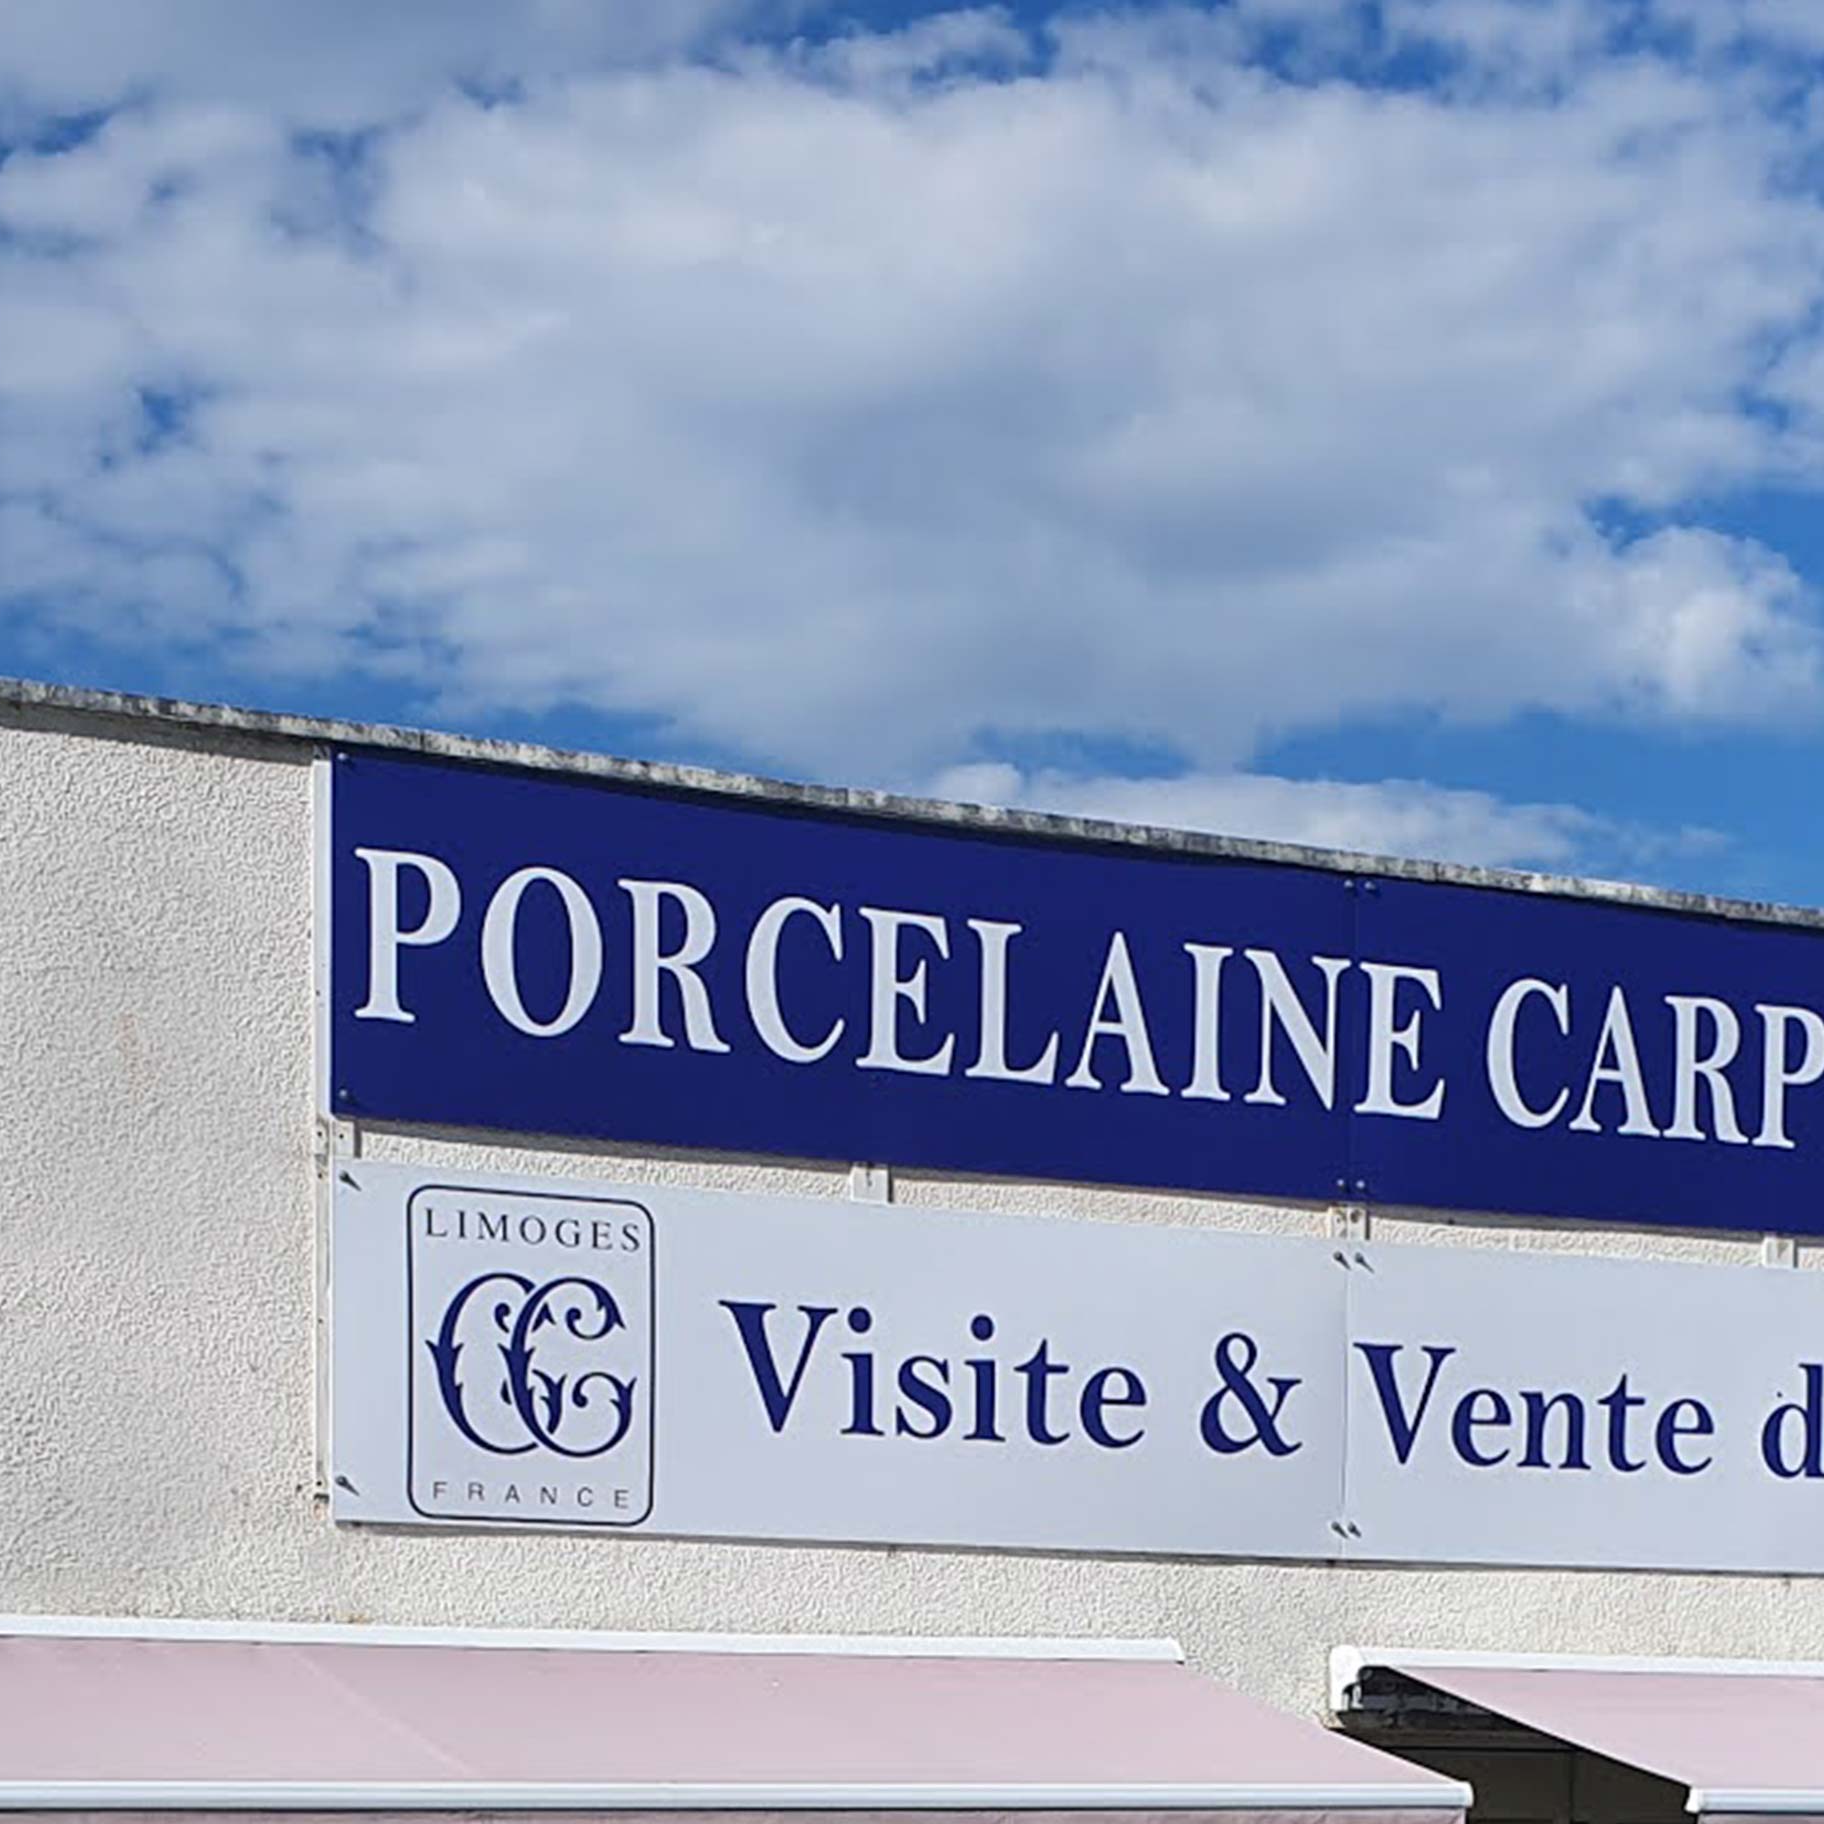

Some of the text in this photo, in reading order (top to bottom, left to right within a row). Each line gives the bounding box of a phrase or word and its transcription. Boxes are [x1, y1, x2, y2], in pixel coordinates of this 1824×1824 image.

[354, 846, 1446, 1121] PORCELAINE
[425, 1206, 641, 1252] LIMOGES
[718, 1298, 1148, 1450] Visite
[1199, 1331, 1304, 1458] &
[1351, 1341, 1715, 1476] Vente
[432, 1479, 630, 1510] FRANCE
